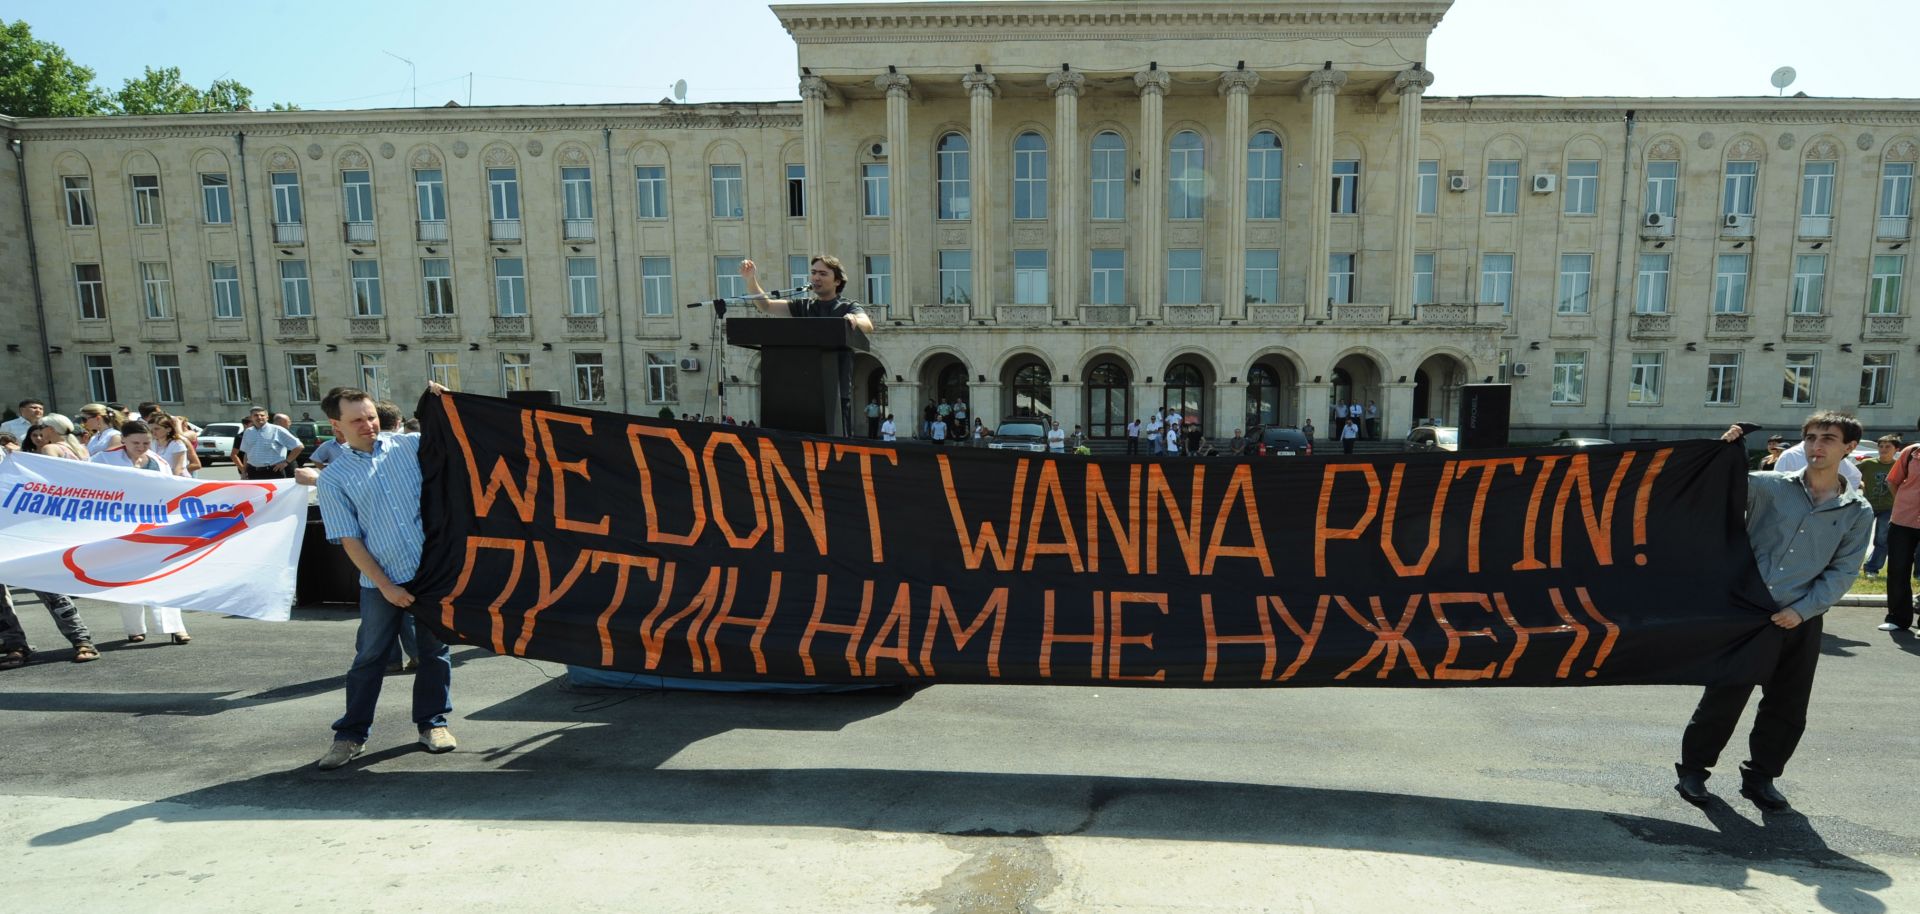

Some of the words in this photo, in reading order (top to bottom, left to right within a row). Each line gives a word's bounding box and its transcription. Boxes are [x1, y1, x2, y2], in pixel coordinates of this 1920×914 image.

[2, 483, 169, 523] Гражданский
[24, 481, 125, 501] ОБЪЕДИНЕННЫЙ
[442, 393, 611, 536] WE
[626, 424, 899, 562] DON'T
[936, 454, 1274, 576] WANNA
[1314, 448, 1673, 578] PUTIN!
[440, 535, 782, 673] ПУТИН
[798, 574, 1008, 678] НАМ
[1039, 587, 1170, 681] НЕ
[1202, 587, 1621, 681] НУЖЕН!
